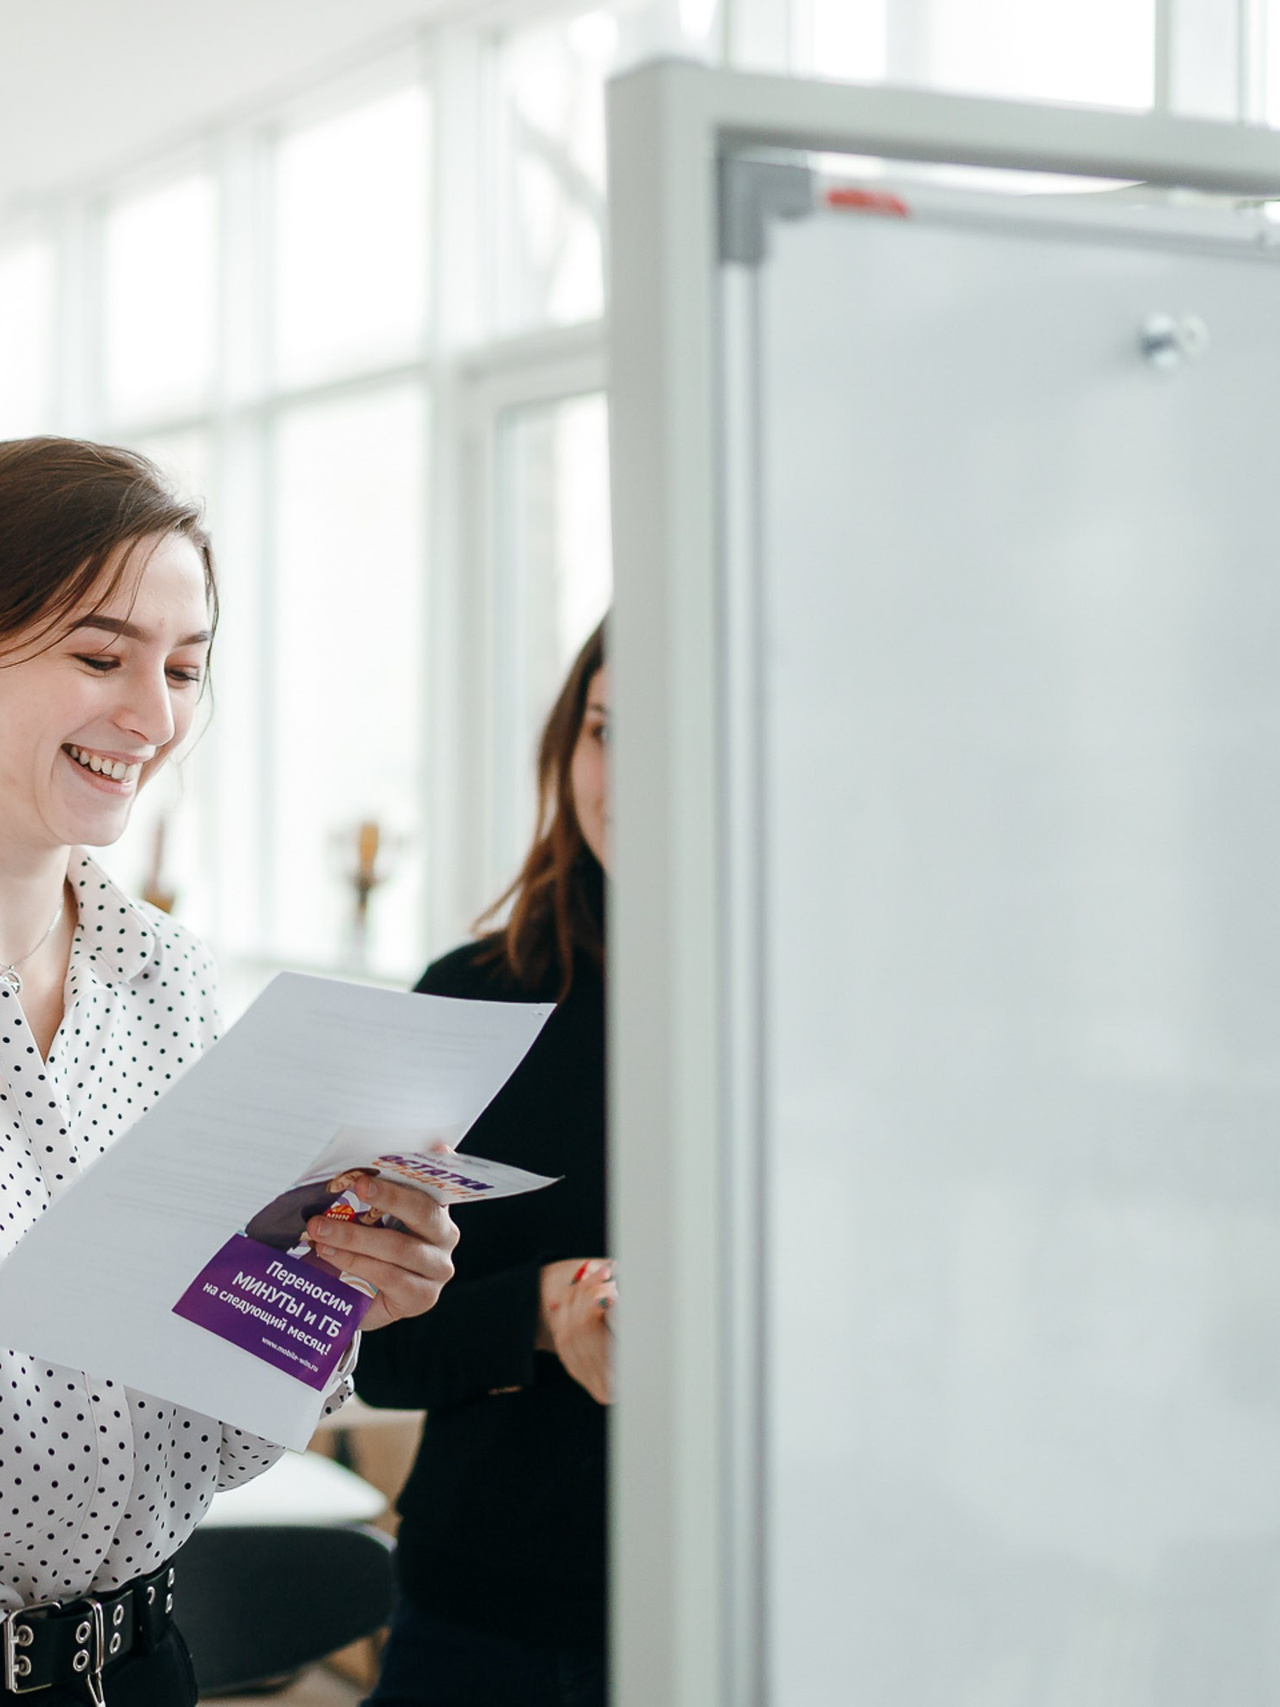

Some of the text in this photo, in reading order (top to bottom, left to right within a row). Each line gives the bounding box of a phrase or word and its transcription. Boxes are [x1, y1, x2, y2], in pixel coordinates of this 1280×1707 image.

[378, 1154, 495, 1191] ОСТАТКИ
[232, 1271, 342, 1338] МИНУТЫ и ГБ
[266, 1260, 353, 1316] Переносим
[202, 1282, 332, 1356] на следующий месяц!
